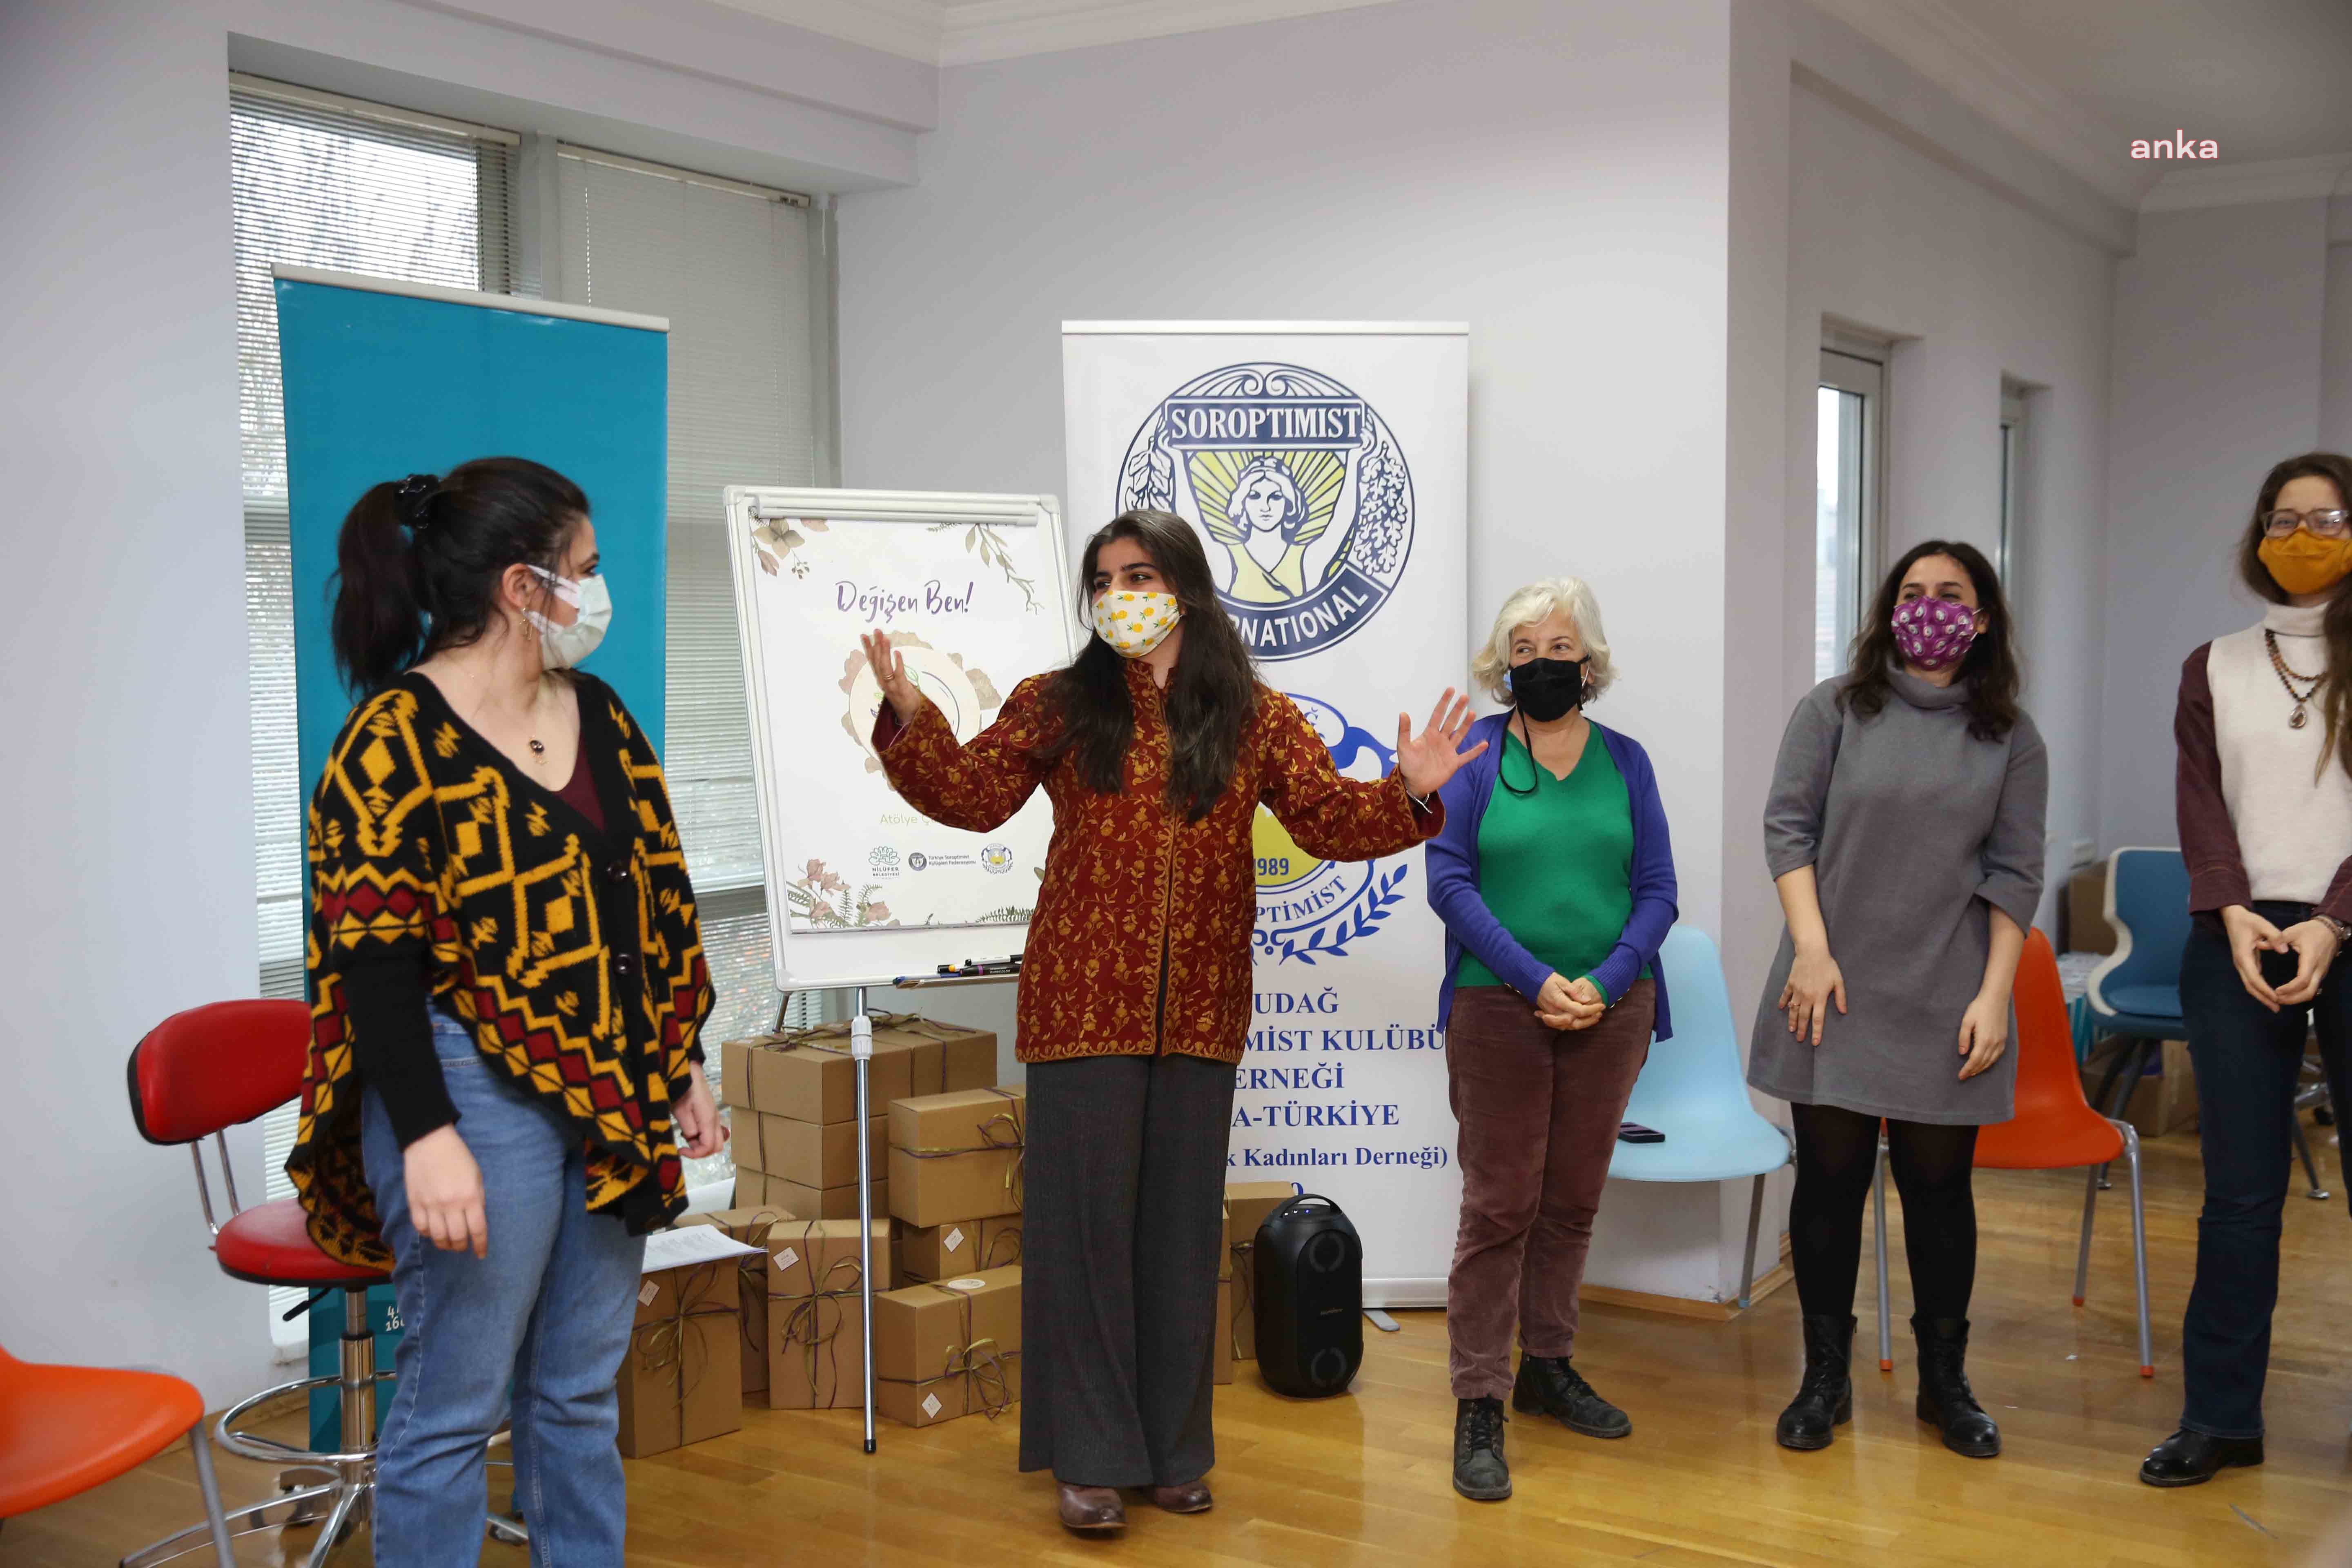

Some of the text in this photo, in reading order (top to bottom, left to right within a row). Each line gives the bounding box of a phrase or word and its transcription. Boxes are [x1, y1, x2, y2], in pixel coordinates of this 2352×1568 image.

[1171, 408, 1361, 439] SOROPTIMIST
[835, 579, 974, 624] Değişen Ben!
[1228, 585, 1369, 646] NATIONAL
[880, 813, 918, 827] Atölye
[1256, 875, 1347, 923] PTİMİST
[1254, 987, 1339, 1014] UDAĞ
[1246, 1025, 1313, 1052] MİST
[1234, 1062, 1345, 1089] ERNEĞİ
[1231, 1100, 1399, 1127] A-TÜRKİYE
[1243, 1147, 1347, 1166] Kadınları
[1355, 1146, 1448, 1169] Derneği)
